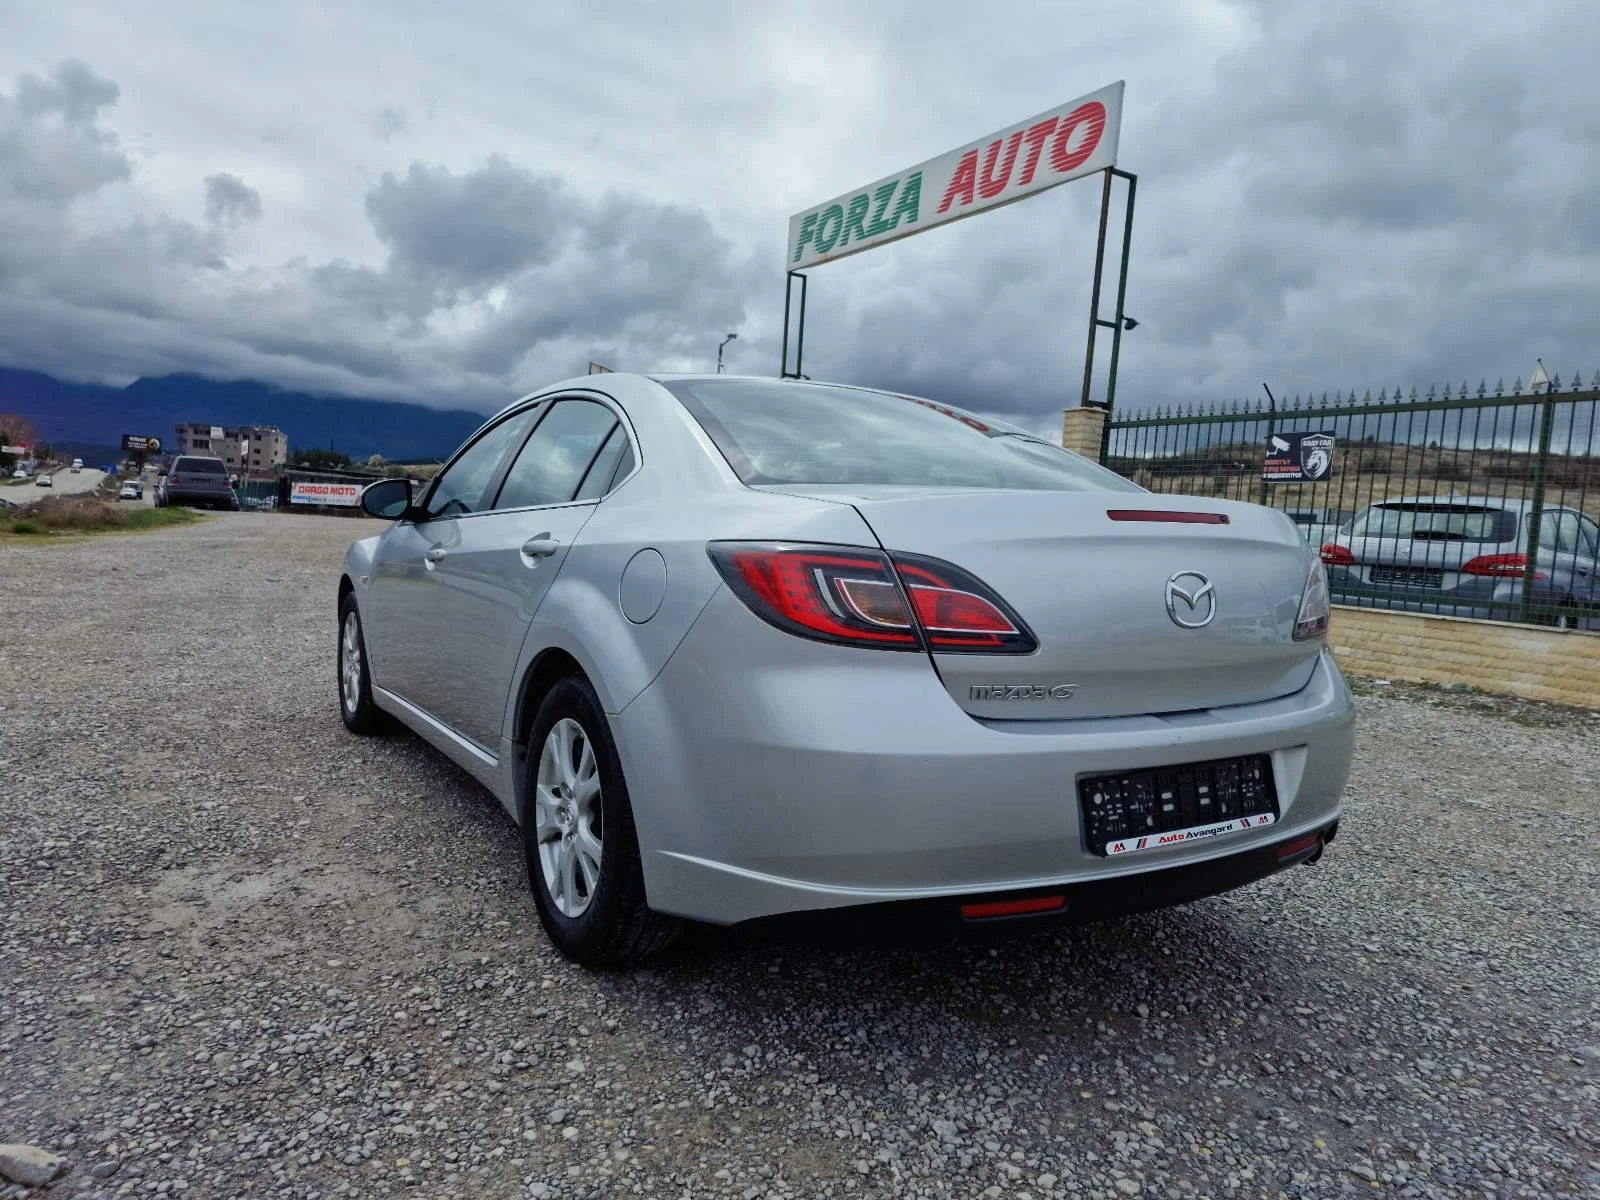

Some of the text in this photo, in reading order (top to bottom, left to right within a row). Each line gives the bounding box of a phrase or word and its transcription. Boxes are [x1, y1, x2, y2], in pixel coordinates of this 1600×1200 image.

[793, 101, 1106, 262] FORZA AUTO
[298, 485, 356, 496] DRAGO MOTO
[1158, 833, 1185, 844] Auto
[1186, 823, 1233, 839] Avangard
